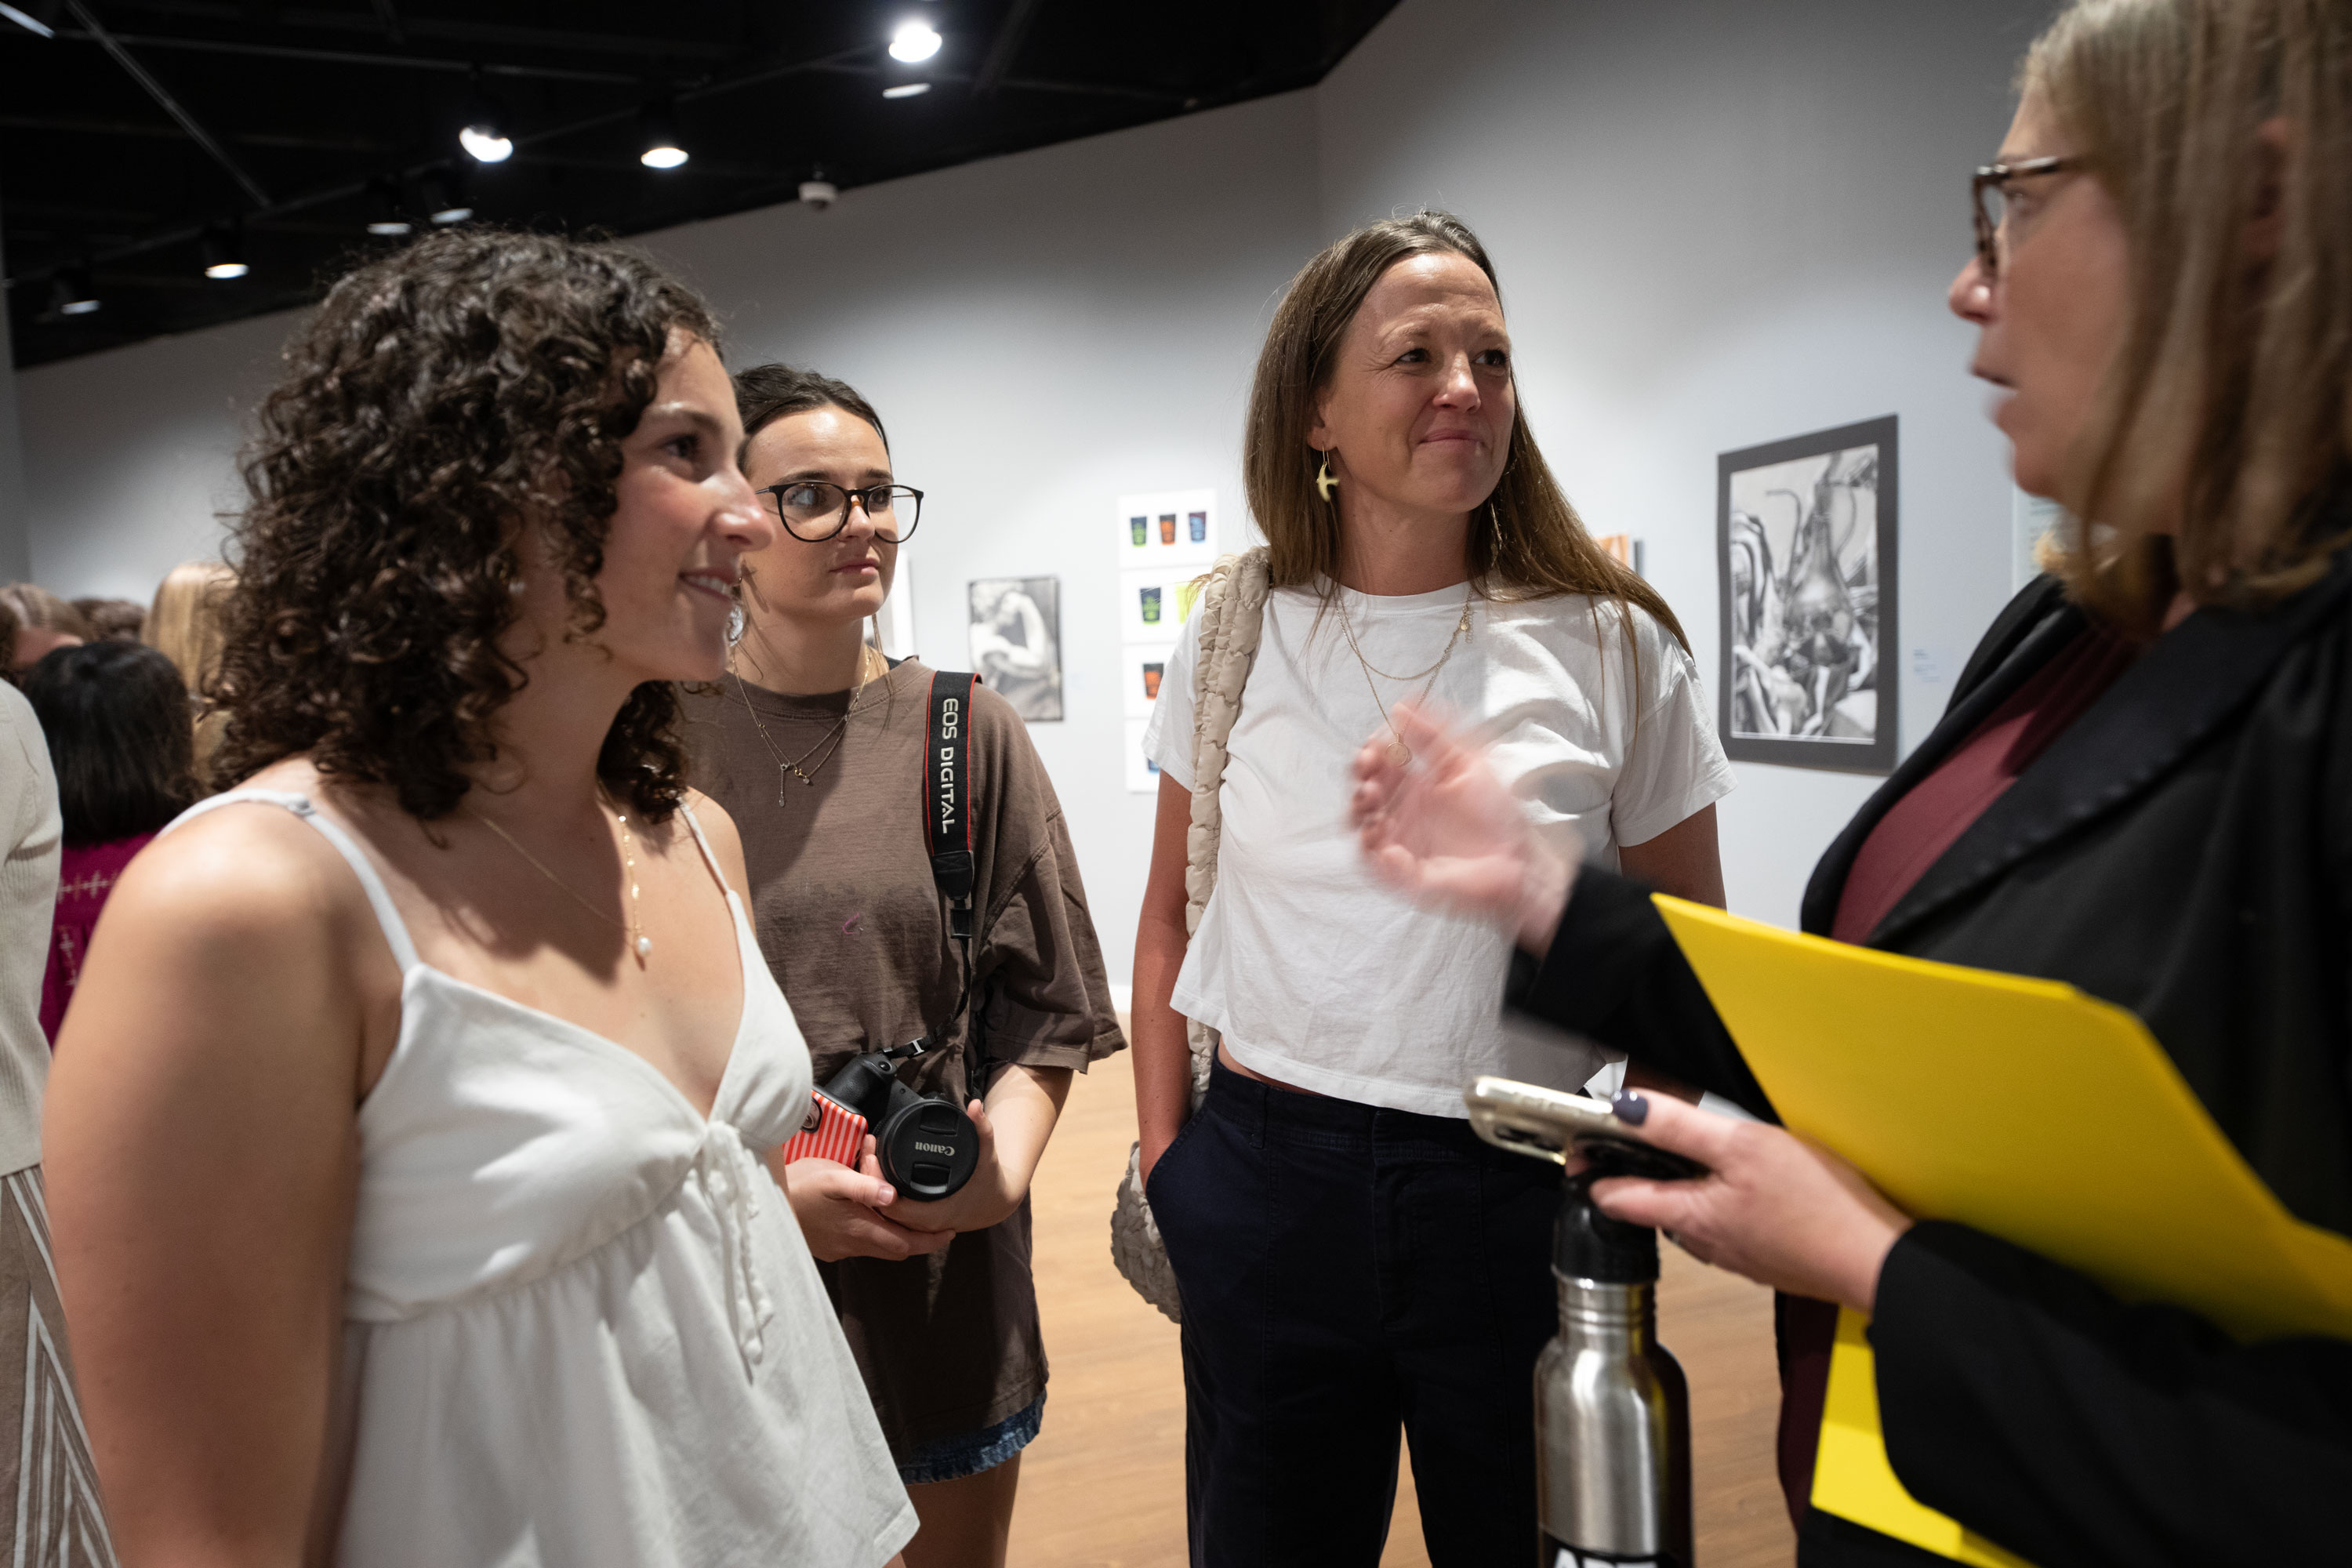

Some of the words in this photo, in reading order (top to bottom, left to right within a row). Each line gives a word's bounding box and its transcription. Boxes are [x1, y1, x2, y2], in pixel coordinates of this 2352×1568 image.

[942, 698, 959, 739] EOS
[940, 746, 955, 834] DIGITAL
[914, 1141, 955, 1156] Canon
